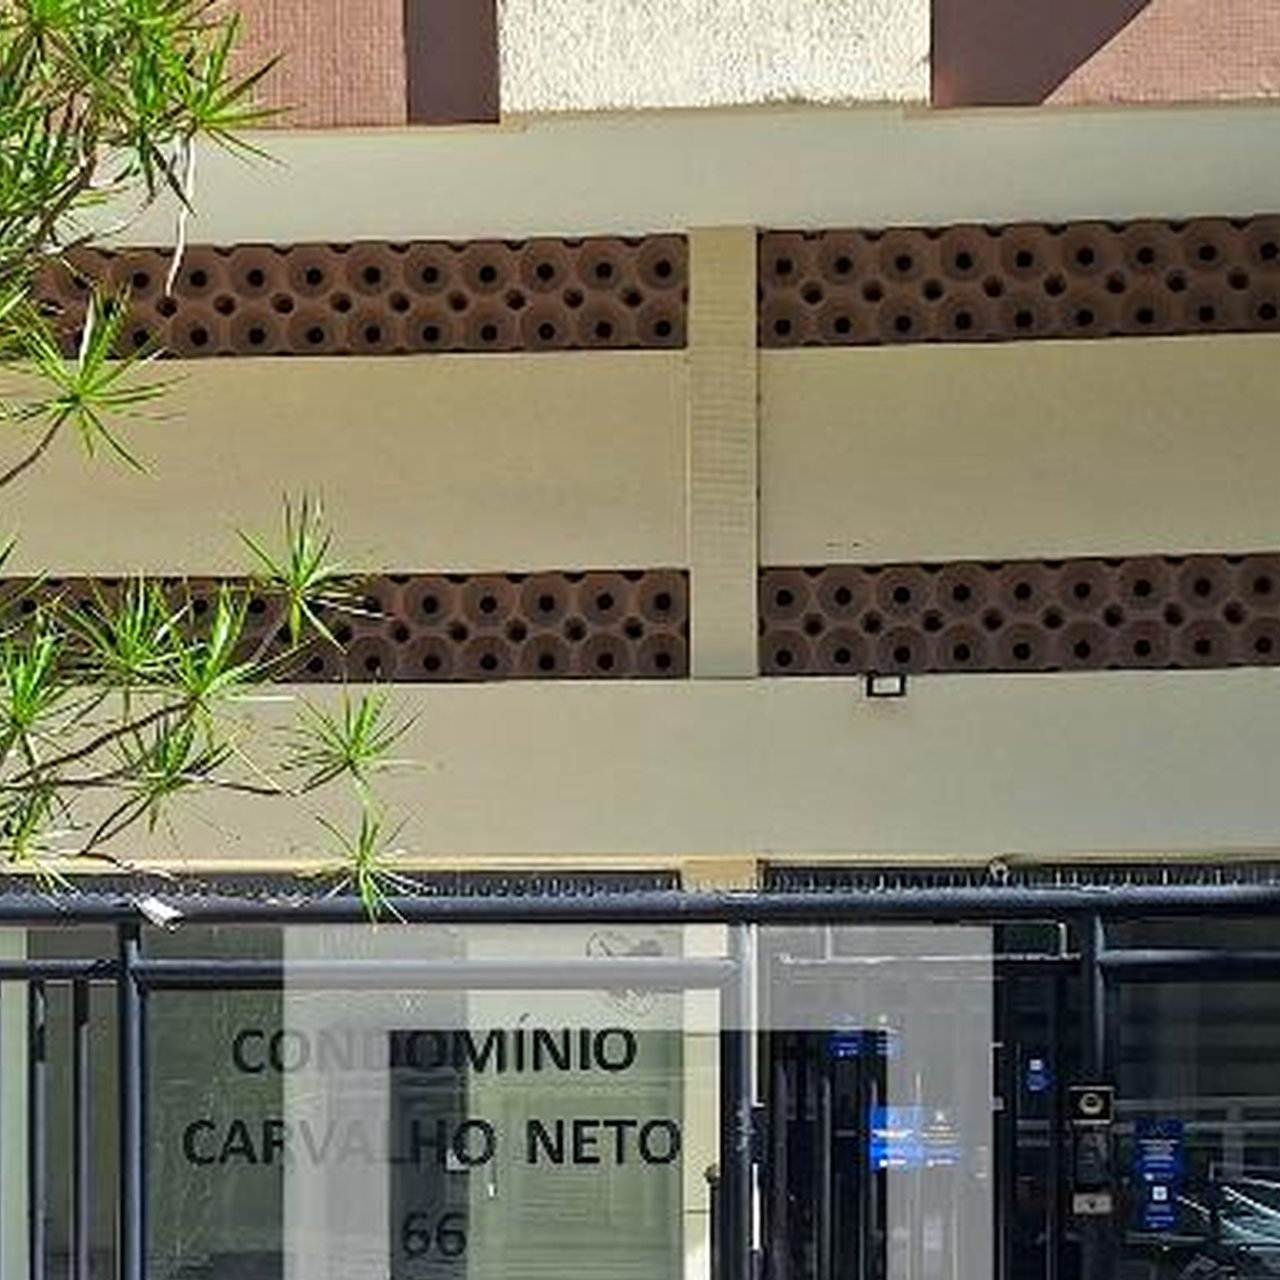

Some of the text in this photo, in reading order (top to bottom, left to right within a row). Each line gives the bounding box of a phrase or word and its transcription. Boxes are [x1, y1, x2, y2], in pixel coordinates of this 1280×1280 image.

[232, 1013, 638, 1073] CONDOMÍNIO
[182, 1118, 682, 1166] CARVALHO NETO
[401, 1212, 469, 1257] 66
